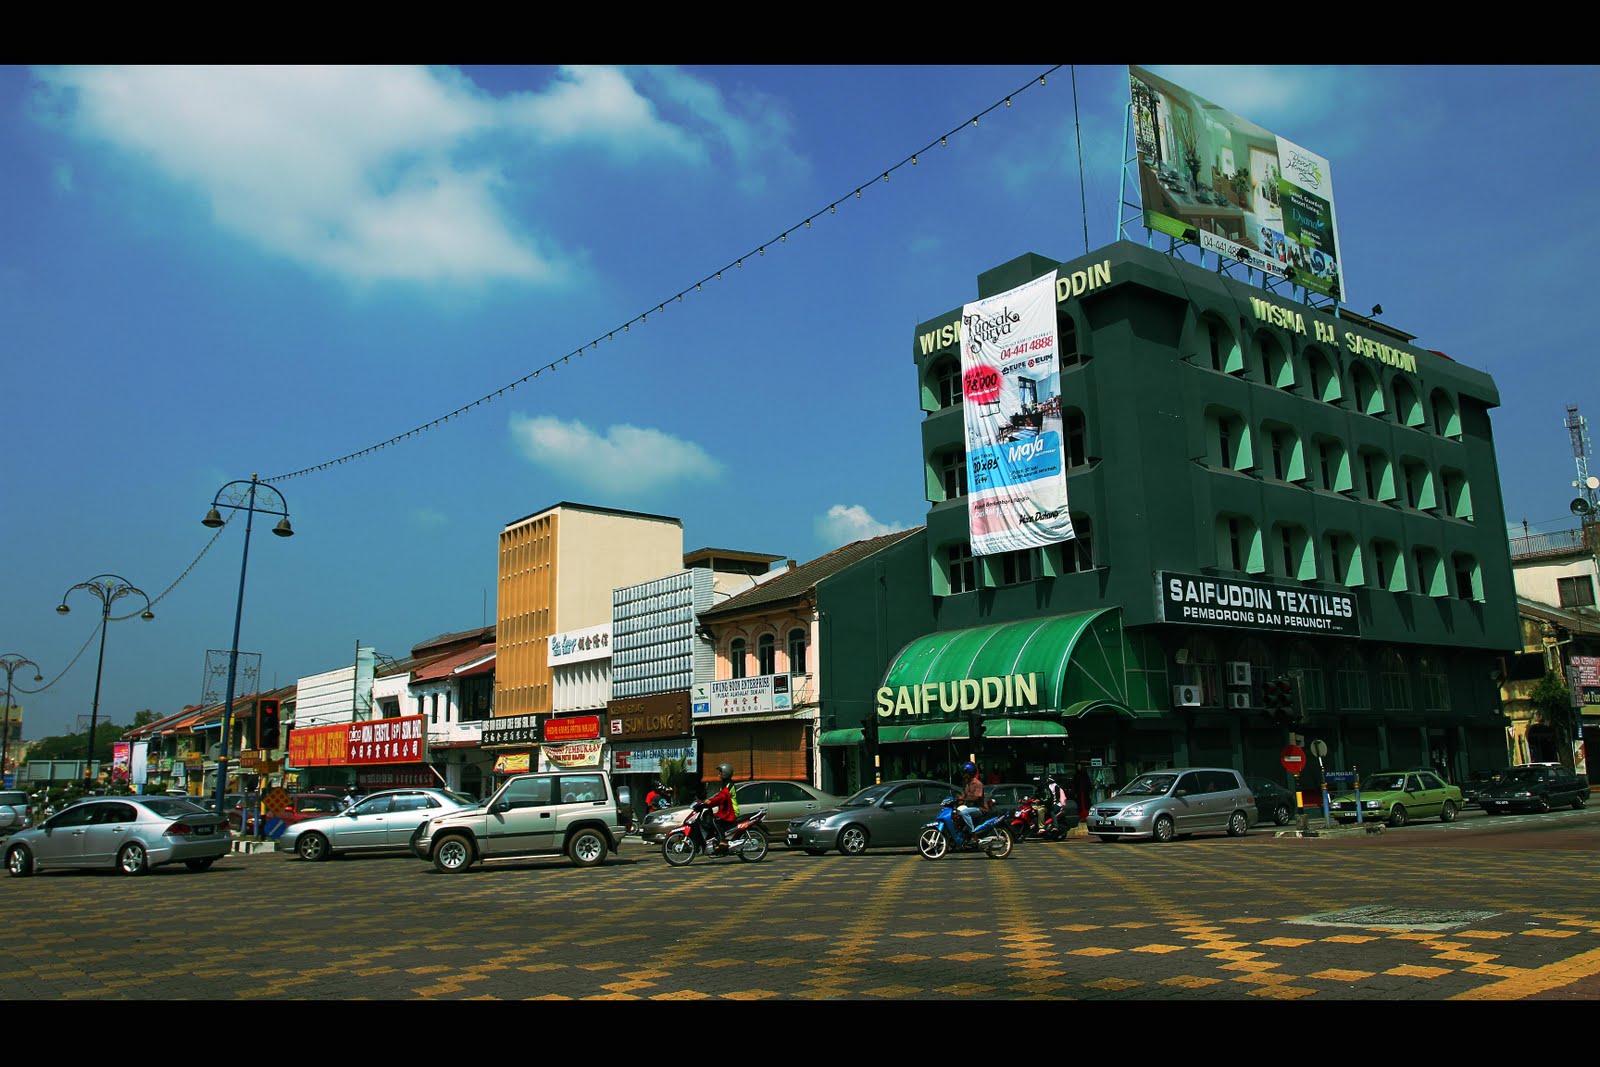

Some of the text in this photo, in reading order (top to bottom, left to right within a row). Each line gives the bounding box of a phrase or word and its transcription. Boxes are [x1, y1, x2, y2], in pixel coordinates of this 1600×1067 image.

[964, 306, 1020, 337] Puncak
[1250, 296, 1307, 336] WISMA
[1345, 331, 1417, 374] SAIFUDDIN
[971, 322, 1011, 354] Surya
[1008, 435, 1043, 463] Maya
[1169, 578, 1353, 618] SAIFUDDIN TEXTILES
[1183, 606, 1331, 629] PEMBORONG DAN PERUNCIT
[729, 680, 740, 691] SOON
[741, 677, 770, 690] ENTERPRISE
[877, 672, 1038, 717] SAIFUDDIN
[627, 703, 644, 714] EMAS
[625, 718, 644, 734] SUM
[647, 713, 674, 732] LONG
[634, 751, 648, 760] KEDAI
[649, 750, 664, 758] EMAS
[667, 748, 679, 758] SUM
